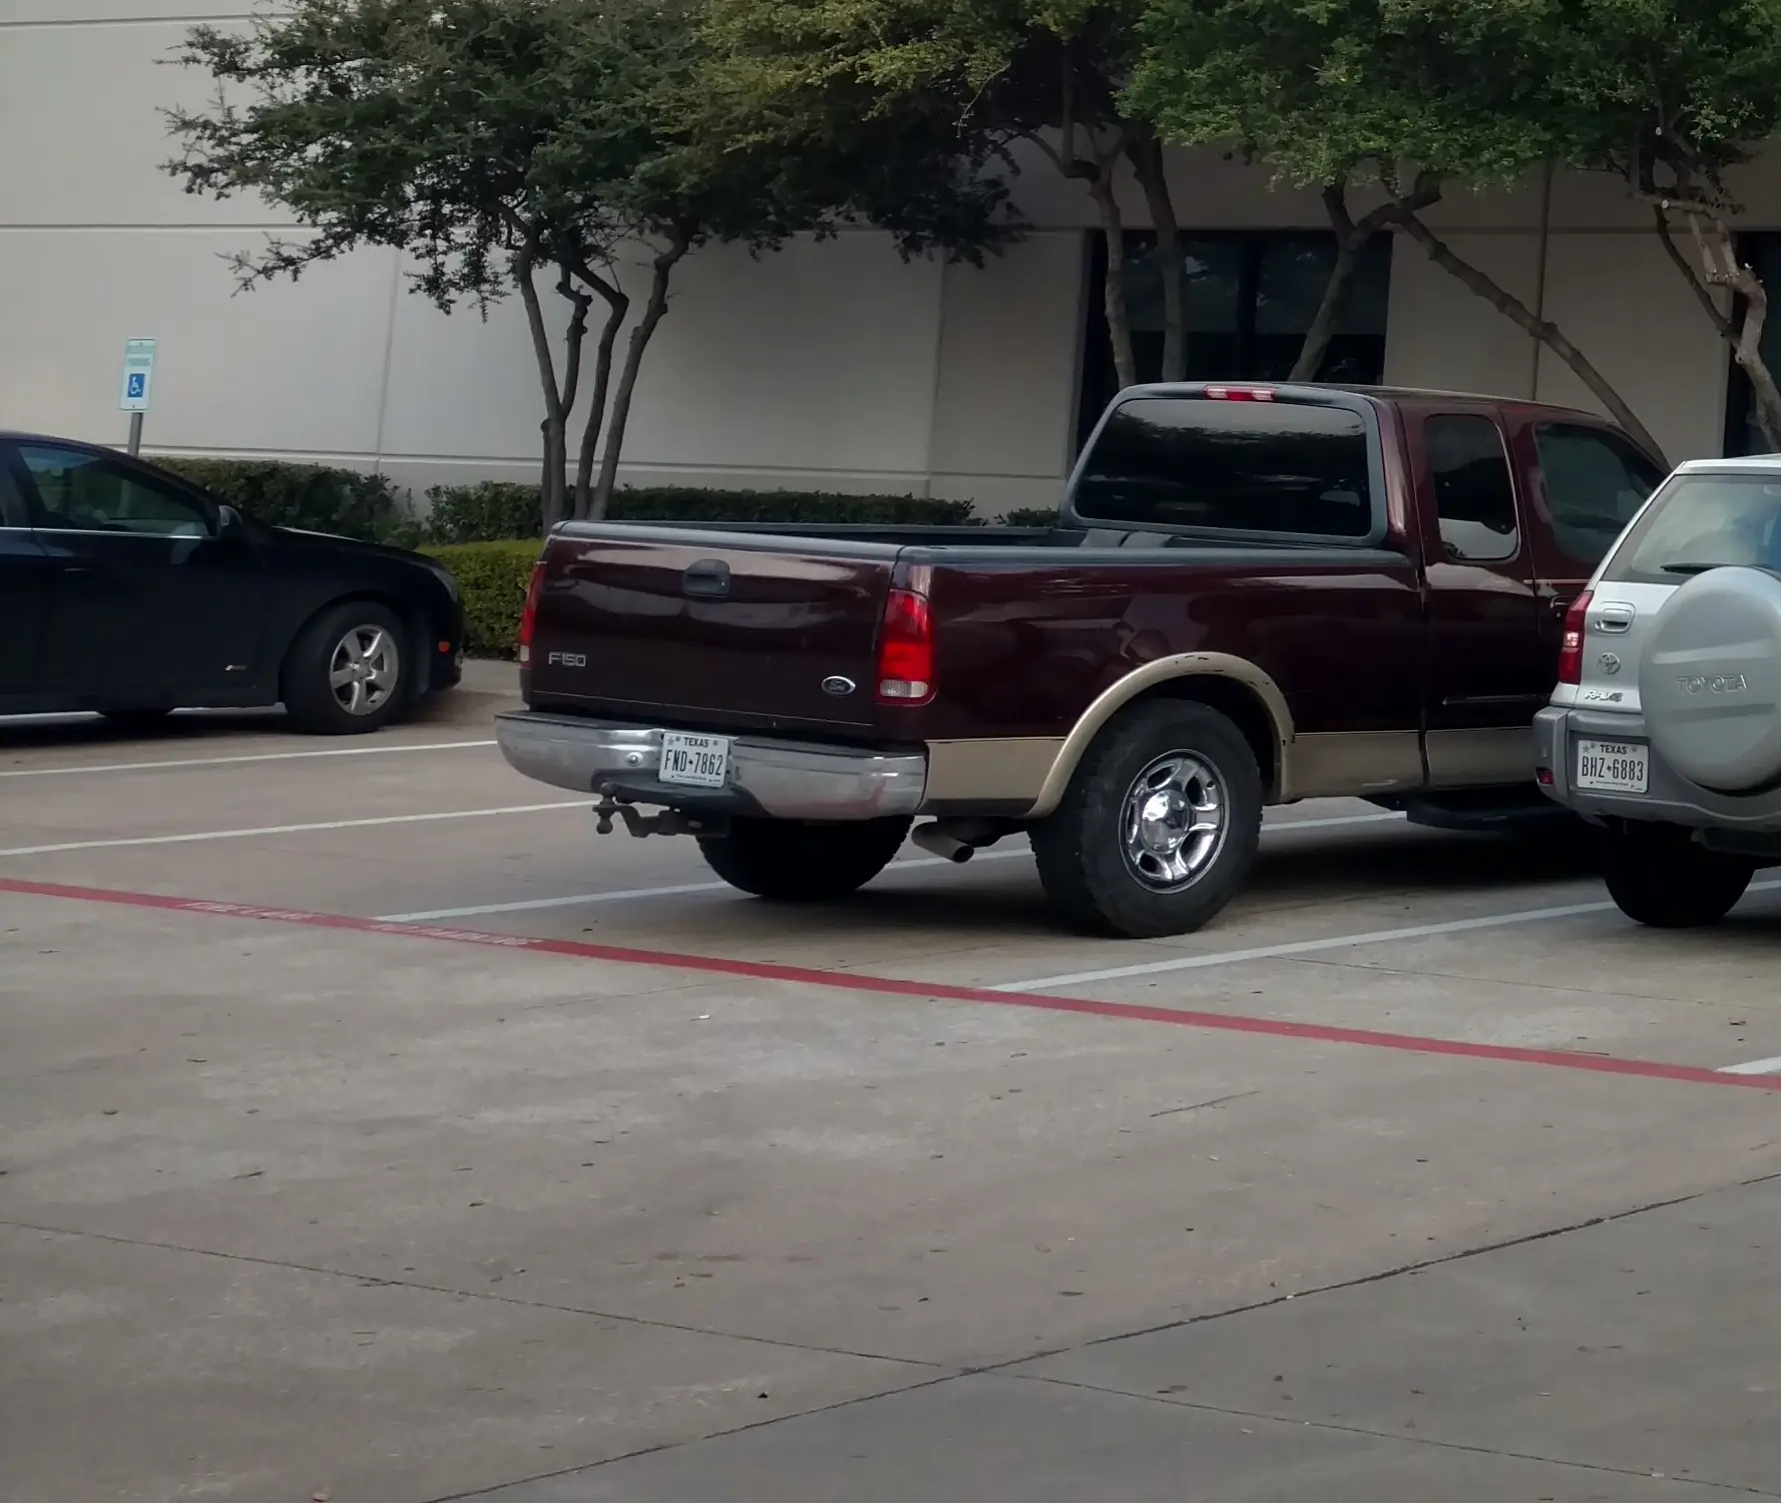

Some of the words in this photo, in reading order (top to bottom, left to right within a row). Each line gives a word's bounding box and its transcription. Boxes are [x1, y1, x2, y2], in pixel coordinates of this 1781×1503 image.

[1676, 673, 1748, 695] TOYOTA
[684, 737, 709, 747] TEXAS
[1600, 744, 1628, 755] TEXAS
